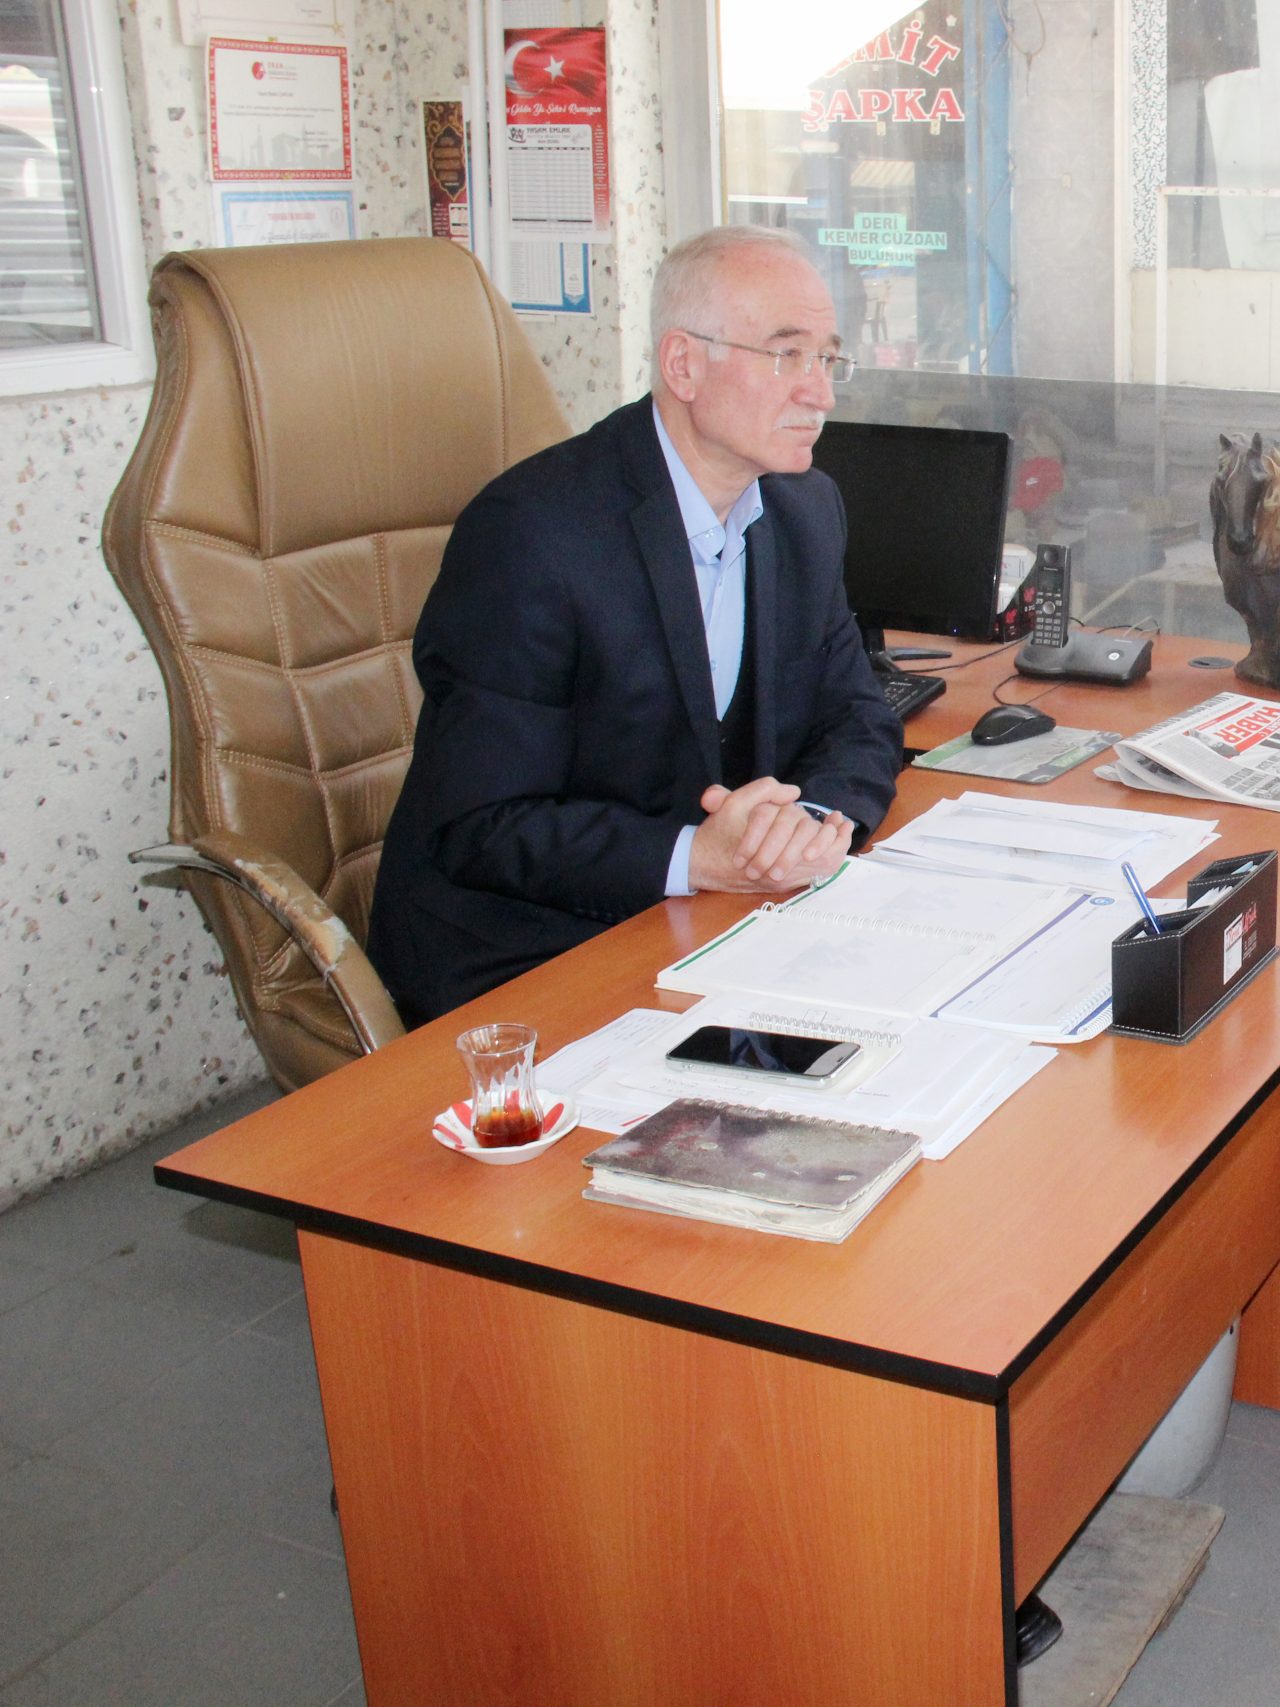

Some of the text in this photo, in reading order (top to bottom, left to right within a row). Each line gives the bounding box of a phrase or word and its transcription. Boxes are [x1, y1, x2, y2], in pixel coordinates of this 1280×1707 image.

[824, 19, 961, 77] MİT
[800, 88, 965, 132] ŞAPKA
[862, 216, 898, 230] DERİ
[824, 231, 879, 245] KEMER
